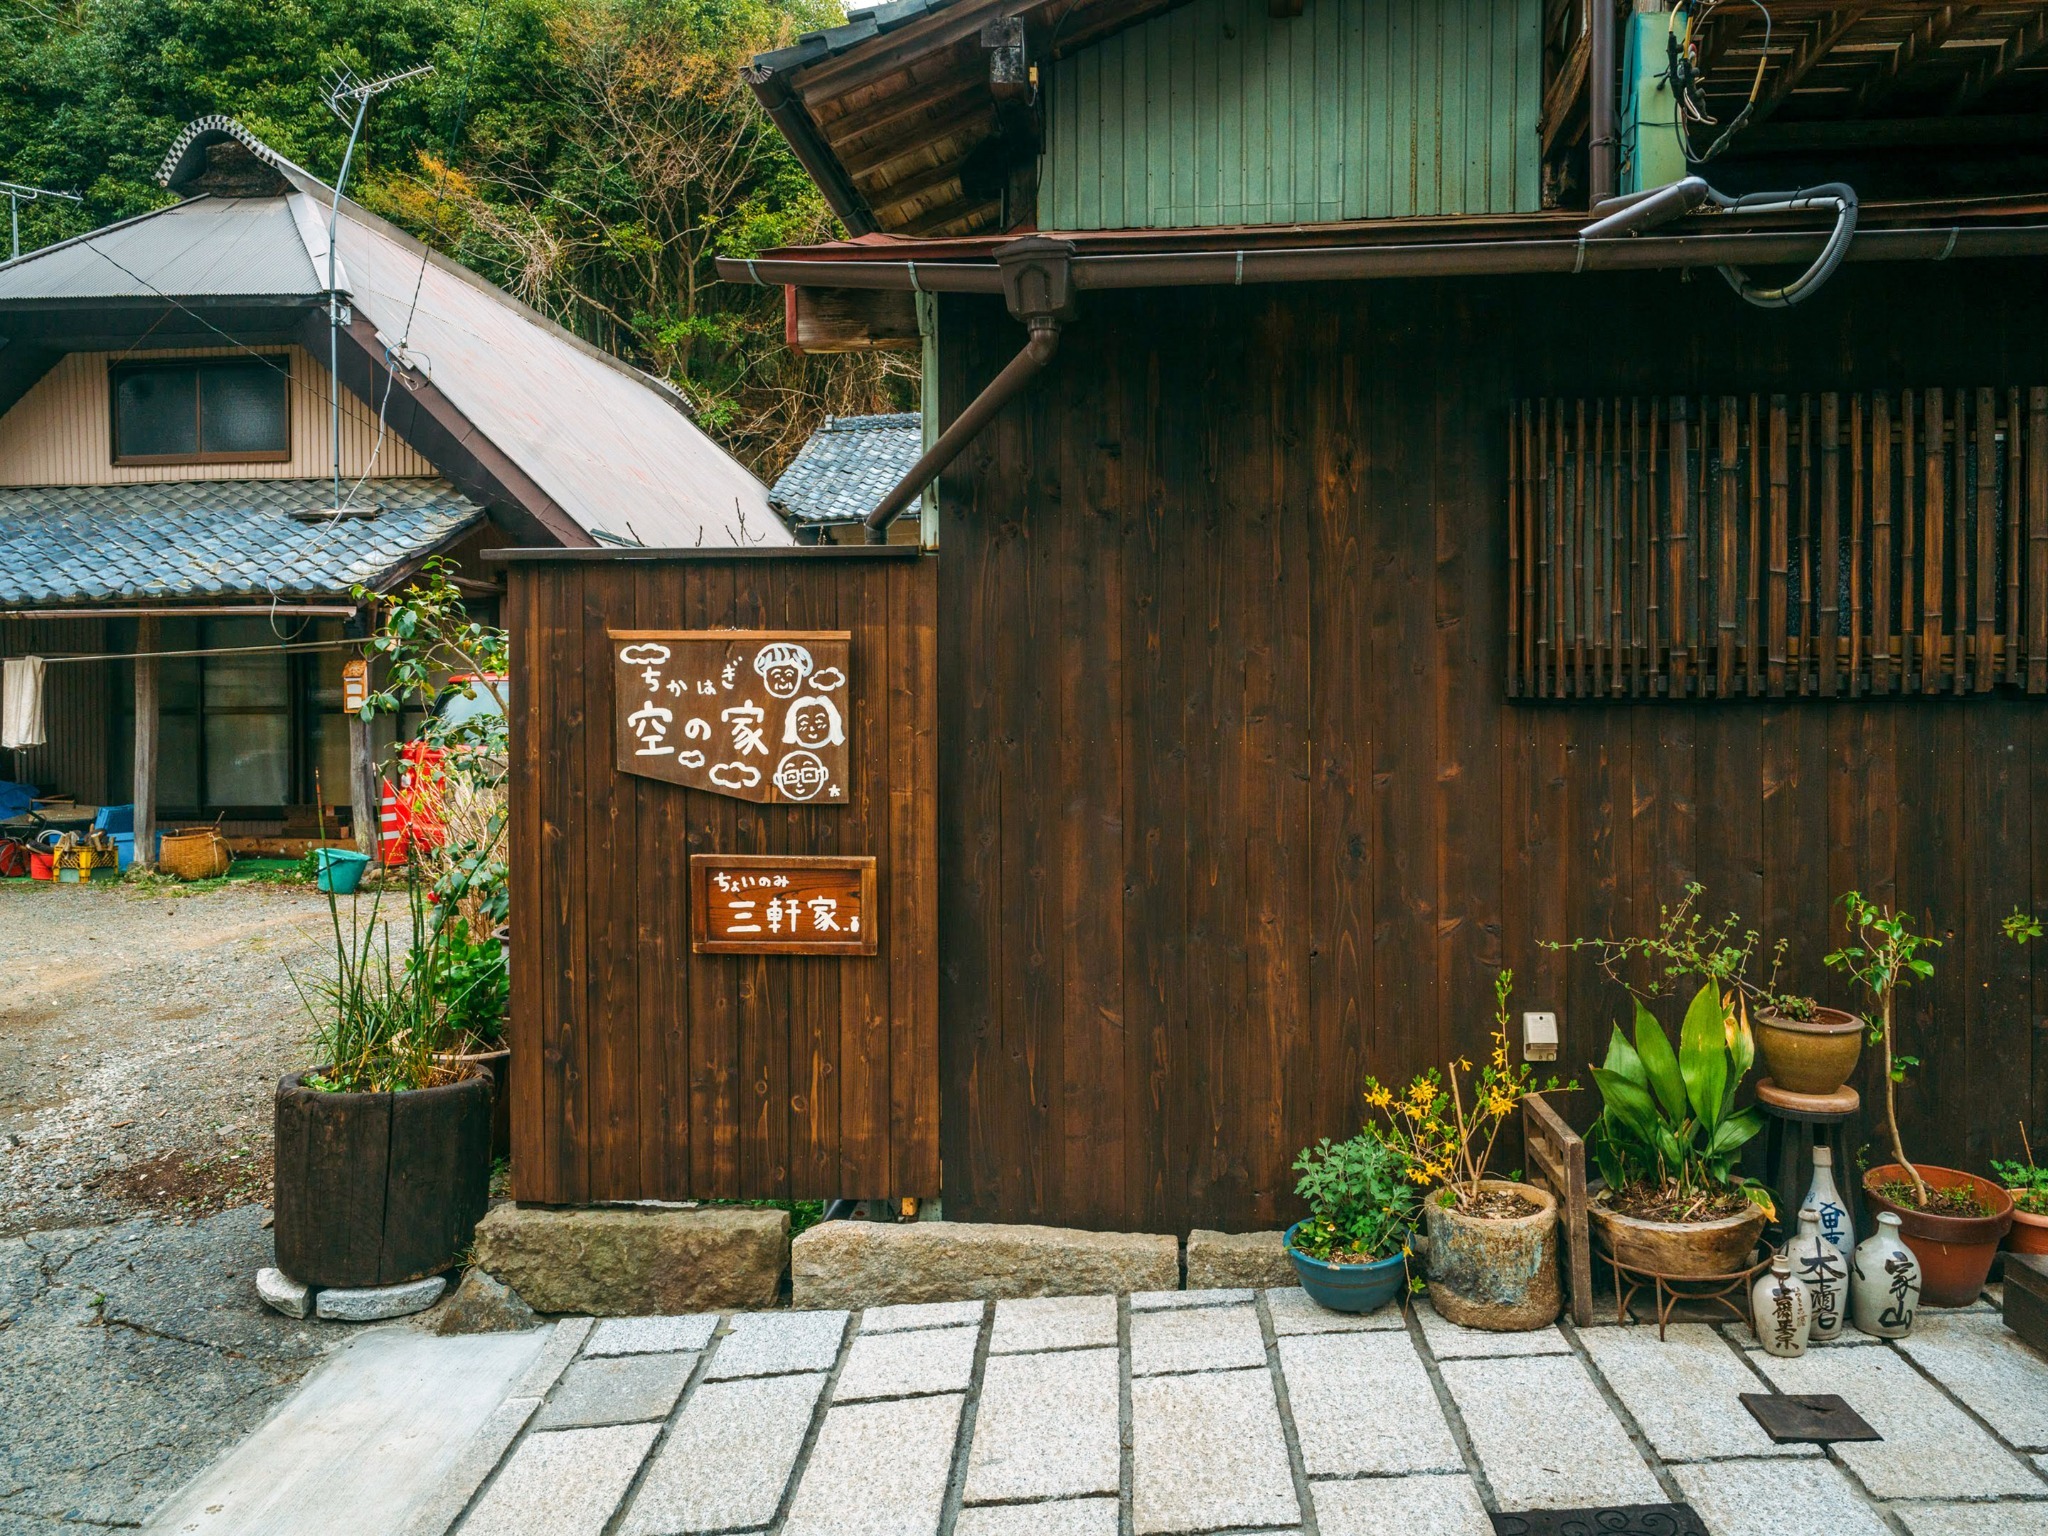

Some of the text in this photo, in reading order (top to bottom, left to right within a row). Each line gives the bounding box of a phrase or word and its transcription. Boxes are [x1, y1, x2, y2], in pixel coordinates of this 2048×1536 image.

[640, 656, 743, 697] ちかはぎ
[627, 699, 769, 756] 空の家
[713, 872, 790, 892] ちょいのみ
[726, 895, 841, 934] 三軒家
